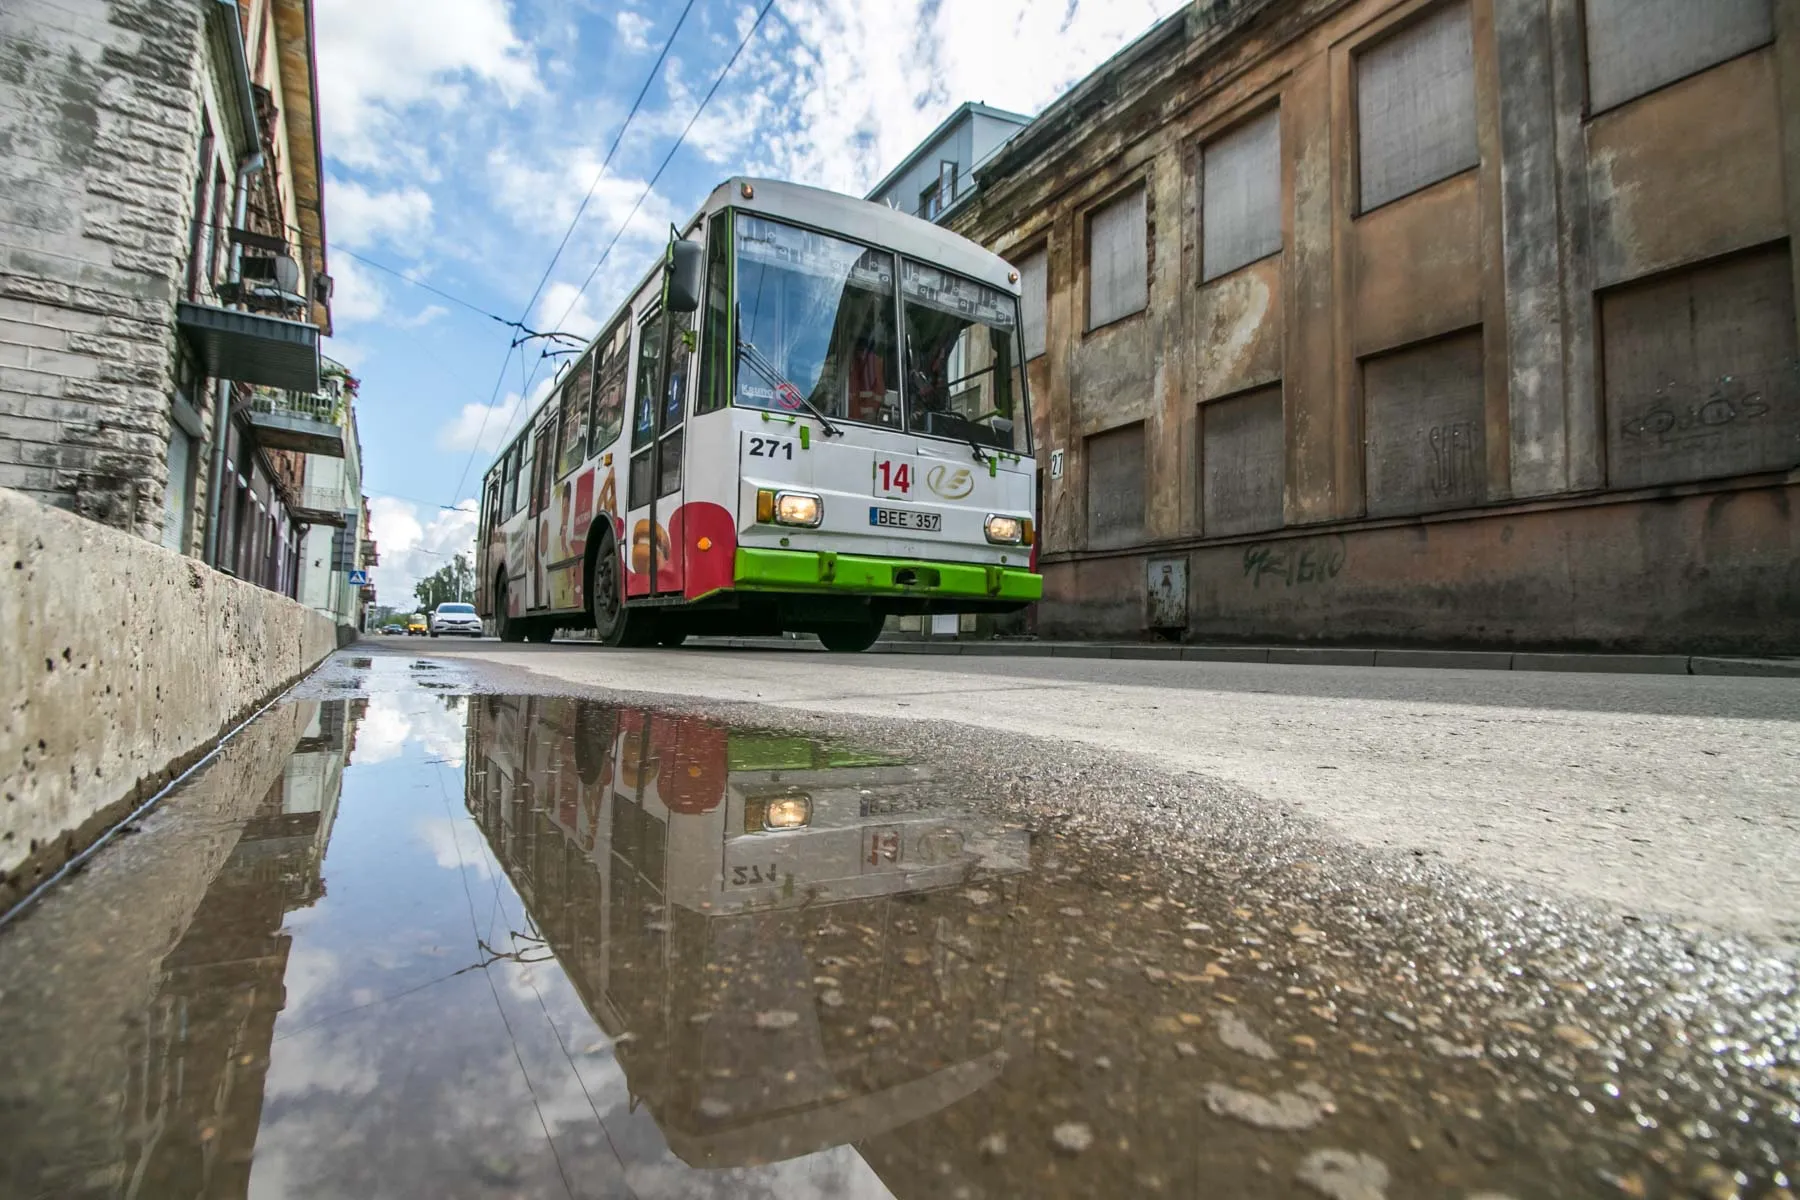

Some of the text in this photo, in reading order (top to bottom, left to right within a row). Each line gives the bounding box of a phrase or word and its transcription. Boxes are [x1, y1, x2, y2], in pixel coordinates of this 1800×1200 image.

[749, 437, 792, 460] 271
[1052, 452, 1063, 476] 27
[879, 460, 910, 493] 14
[878, 510, 939, 530] BEE 357
